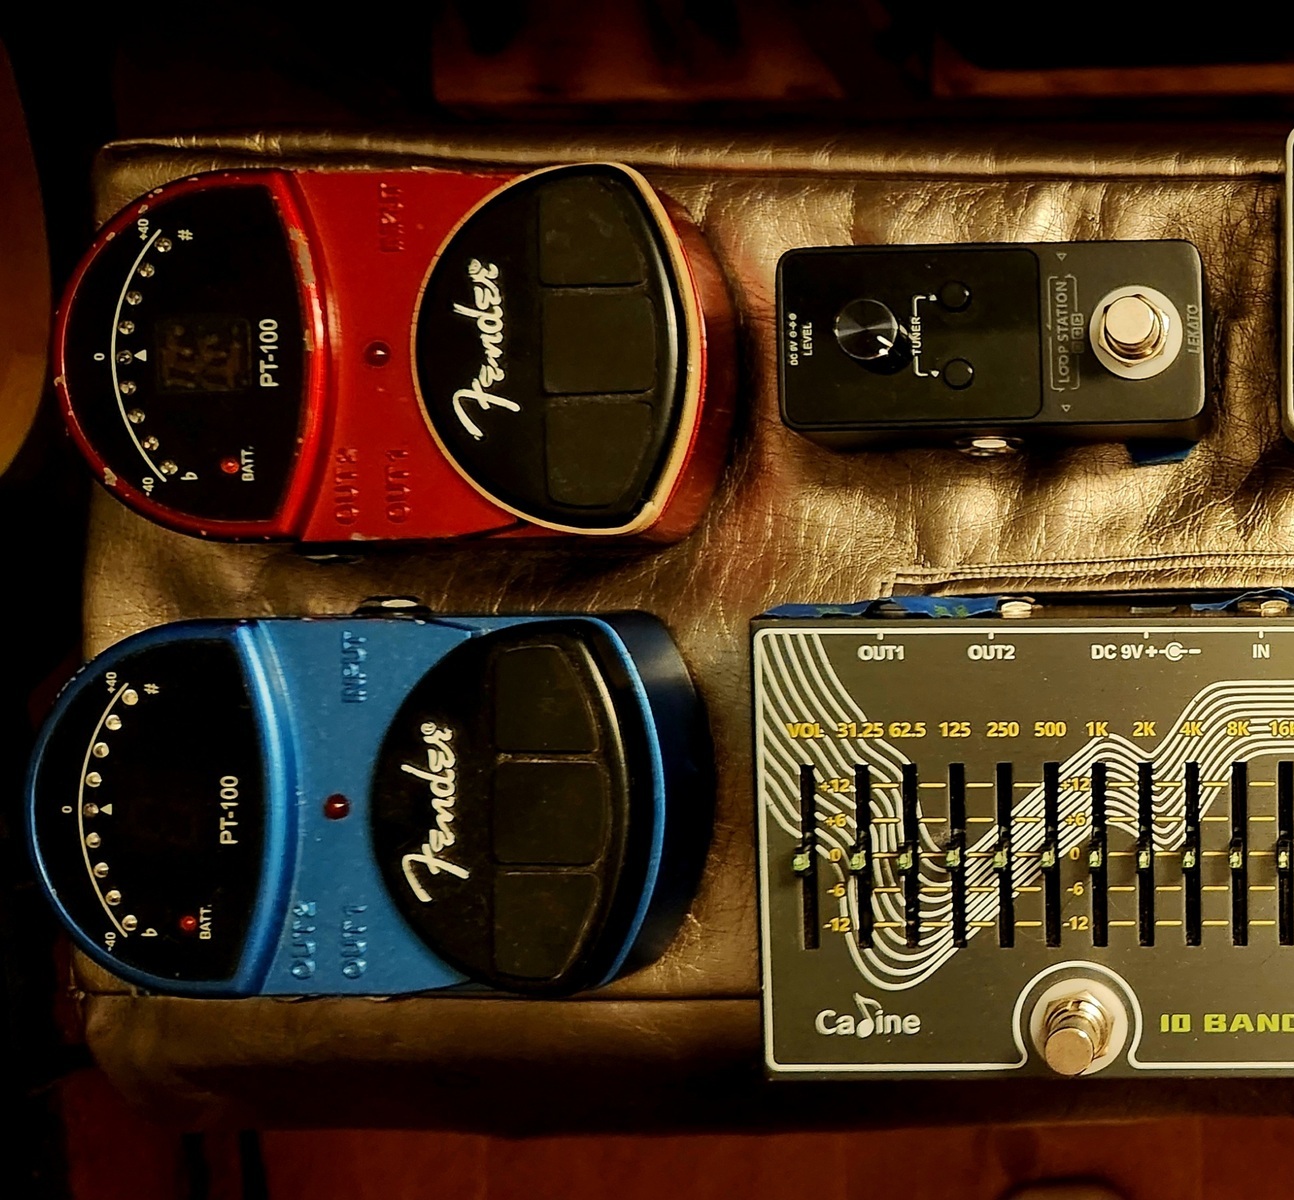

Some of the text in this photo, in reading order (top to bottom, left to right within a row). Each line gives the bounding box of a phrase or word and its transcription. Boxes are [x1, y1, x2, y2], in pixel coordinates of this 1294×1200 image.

[138, 218, 150, 241] +40
[802, 322, 813, 356] LEVEL
[911, 315, 921, 357] TUNER
[1055, 281, 1070, 383] LOOP STATION
[259, 318, 279, 388] PT-100
[857, 645, 905, 661] OUT1
[967, 645, 1015, 661] OUT2
[1091, 644, 1143, 660] DC 9V
[1252, 644, 1270, 659] IN
[106, 671, 118, 694] +40
[787, 723, 824, 738] VOL
[837, 722, 884, 738] 31.25
[889, 722, 926, 738] 62.5
[939, 722, 971, 738] 125
[986, 721, 1019, 738] 250
[1034, 721, 1067, 738] 500
[1086, 721, 1109, 736] 1K
[1132, 721, 1155, 736] 2K
[1180, 721, 1203, 736] 4K
[1226, 721, 1249, 736] 8K
[819, 778, 850, 793] +12
[1060, 778, 1091, 792] +12
[219, 775, 239, 845] PT-100
[824, 814, 847, 828] +6
[1065, 813, 1086, 826] +6
[830, 848, 842, 862] 0
[1070, 847, 1080, 860] 0
[827, 884, 846, 897] -6
[1067, 882, 1084, 896] -6
[823, 918, 850, 932] -12
[1062, 916, 1088, 930] -12
